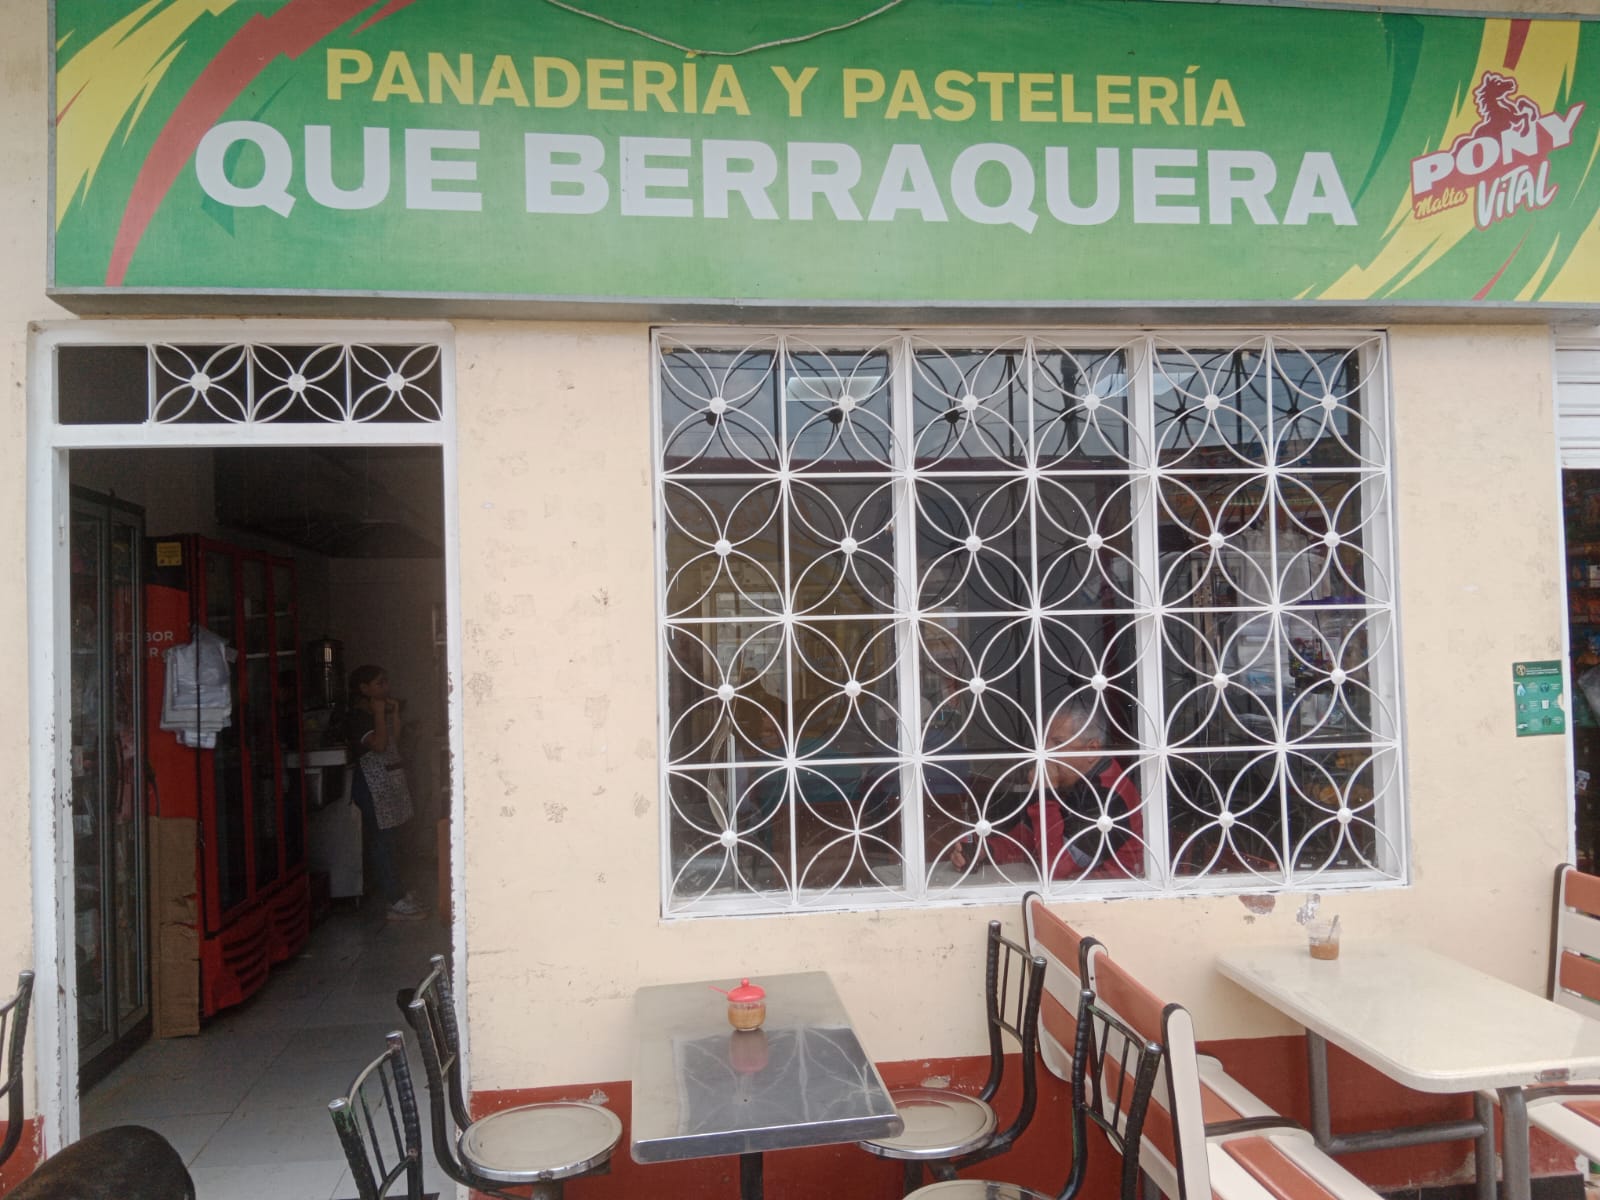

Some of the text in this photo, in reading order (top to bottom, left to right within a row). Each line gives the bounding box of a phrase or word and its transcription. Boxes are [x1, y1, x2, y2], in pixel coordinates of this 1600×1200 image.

[325, 48, 1246, 128] PANADERÍA Y PASTELERÍA
[194, 120, 1359, 235] QUE BERRAQUERA
[1413, 103, 1583, 195] PONY
[1415, 186, 1467, 218] Malta
